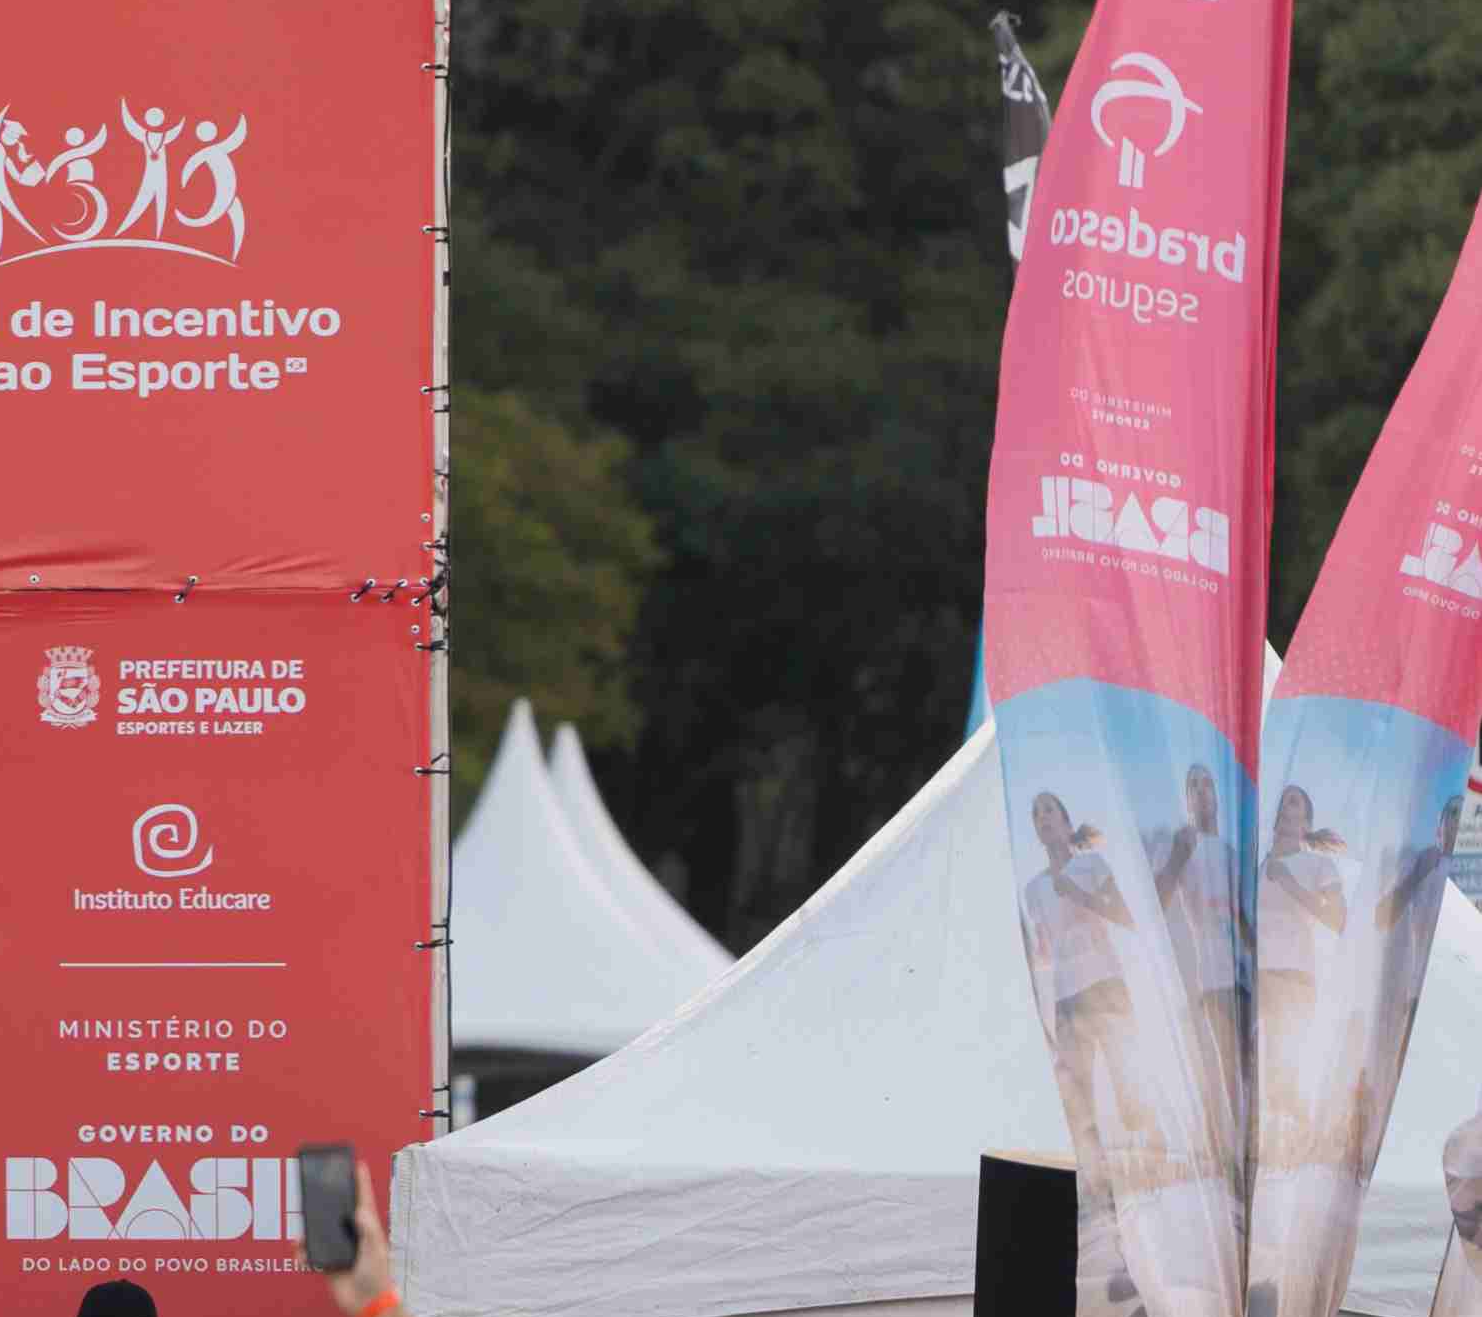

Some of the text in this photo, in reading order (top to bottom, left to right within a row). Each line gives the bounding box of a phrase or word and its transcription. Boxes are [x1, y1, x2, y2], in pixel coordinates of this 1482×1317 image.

[10, 301, 74, 338] de
[94, 299, 341, 337] Incentivo
[71, 352, 280, 398] Esporte
[120, 659, 304, 680] PREFEITURA DE
[117, 682, 306, 715] SÃO PAULO
[116, 720, 263, 735] ESPORTES E LAZER
[74, 885, 271, 910] Instituto Educare
[59, 1015, 287, 1039] MINISTÉRIO DO
[106, 1052, 240, 1071] ESPORTE
[78, 1124, 269, 1143] GOVERNO DO
[22, 1257, 51, 1272] DO
[58, 1257, 111, 1272] LADO
[118, 1257, 147, 1272] DO
[154, 1257, 209, 1272] POVO
